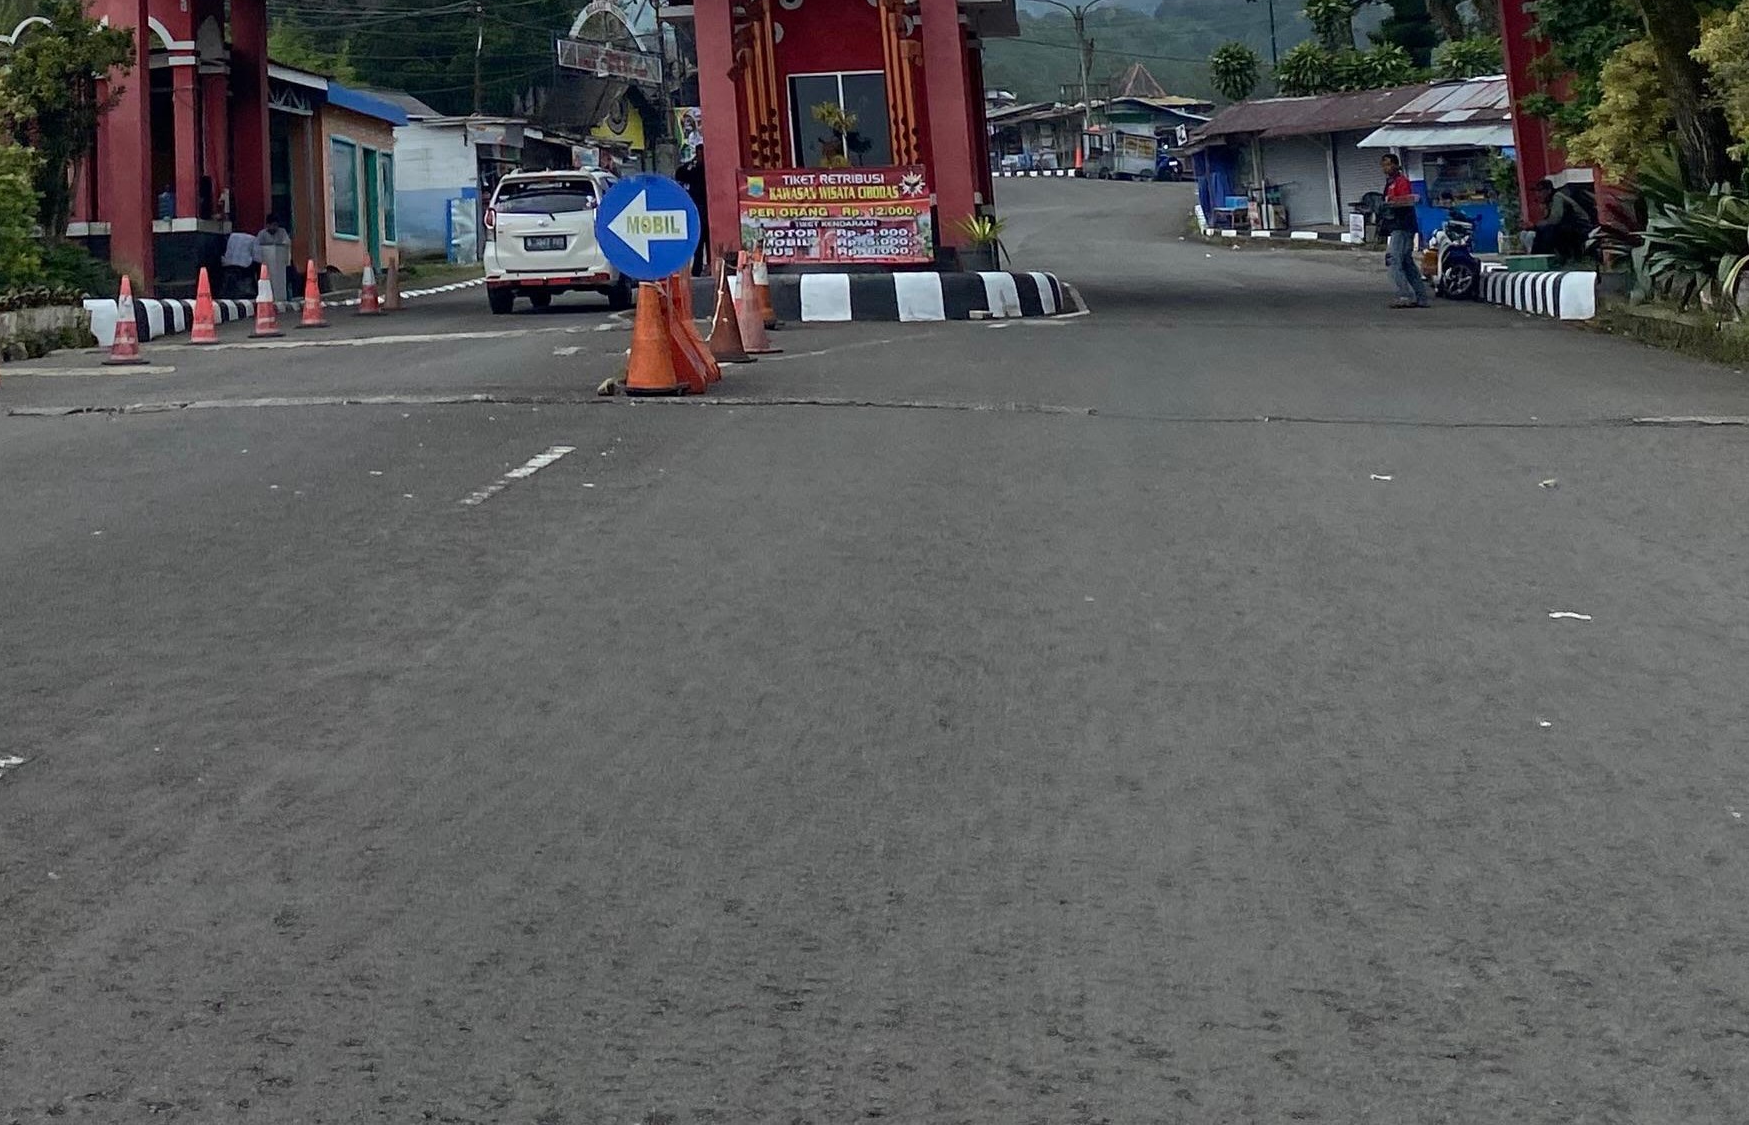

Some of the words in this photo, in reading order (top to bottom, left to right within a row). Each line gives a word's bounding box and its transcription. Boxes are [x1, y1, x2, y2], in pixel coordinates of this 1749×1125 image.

[782, 174, 816, 186] TIKET
[819, 173, 885, 185] RETRIBUSI
[769, 186, 817, 201] KAWASAN
[819, 185, 856, 200] WISATA
[857, 185, 900, 199] CIBODAS
[749, 207, 777, 218] PER
[778, 207, 829, 218] ORANG
[842, 207, 864, 218] Rp.
[626, 215, 680, 236] MOBIL
[821, 219, 878, 227] KENDARAAN
[764, 228, 817, 238] MOTOR
[765, 238, 811, 247] MOBIL
